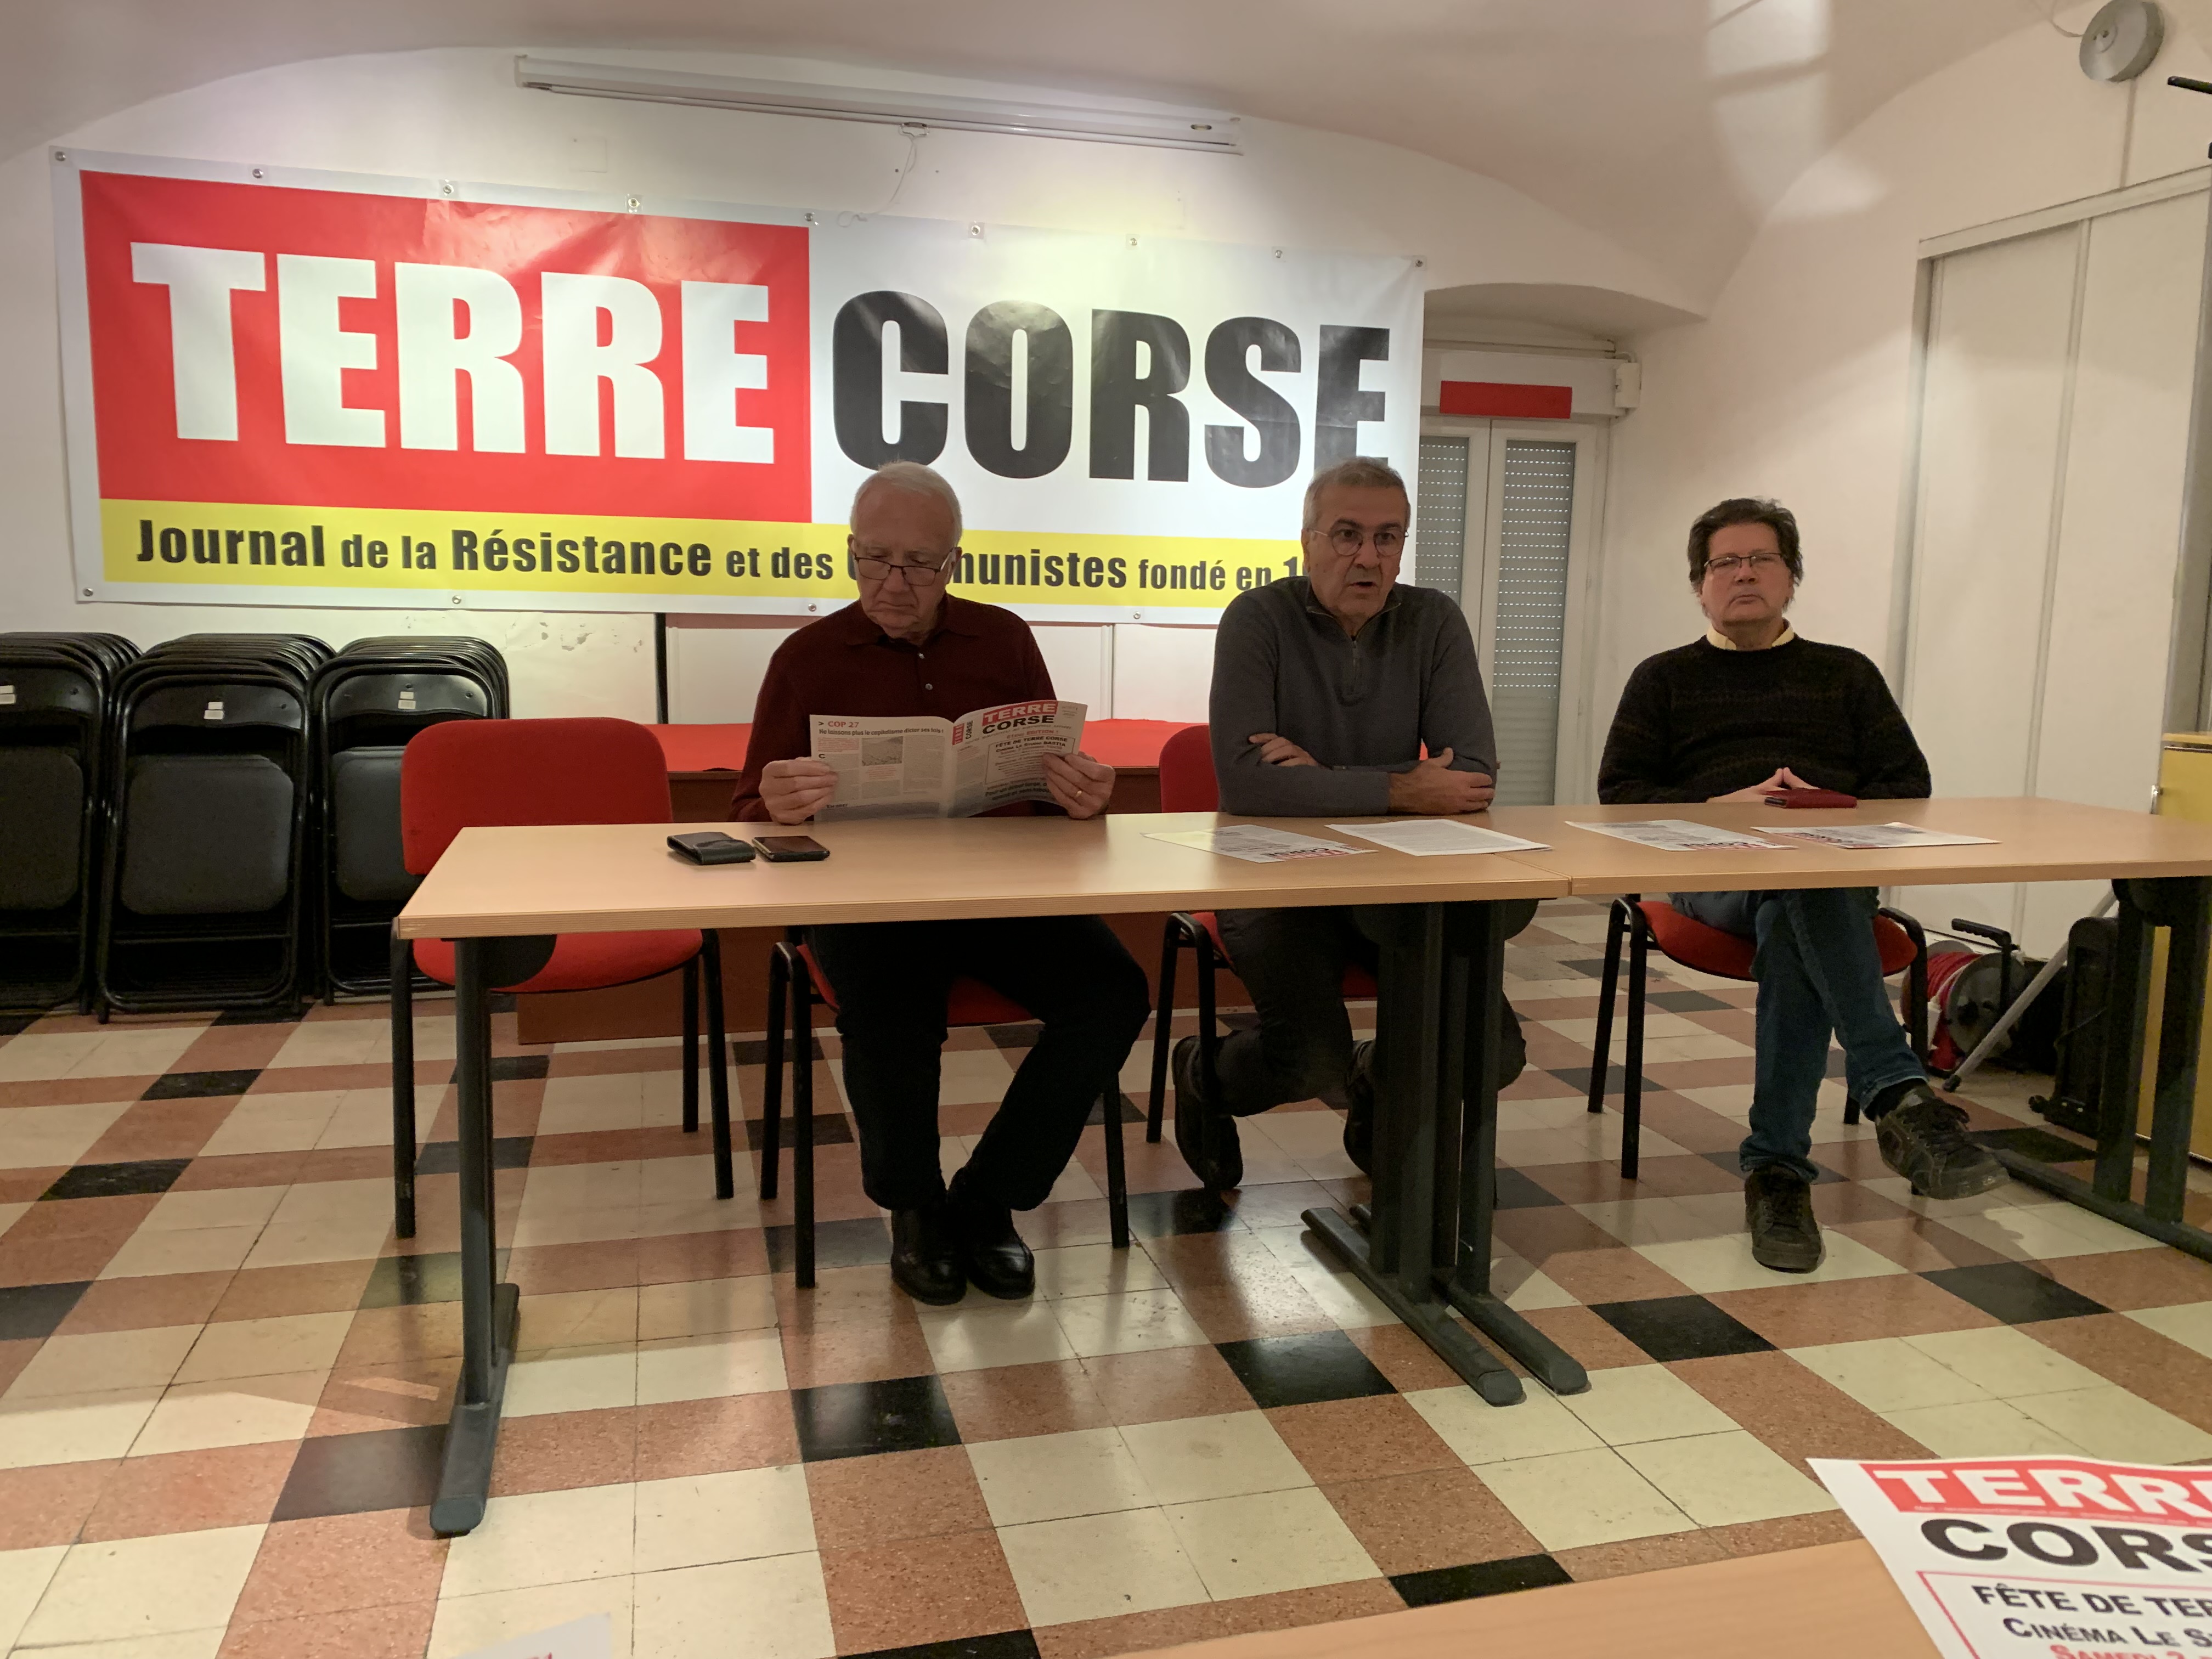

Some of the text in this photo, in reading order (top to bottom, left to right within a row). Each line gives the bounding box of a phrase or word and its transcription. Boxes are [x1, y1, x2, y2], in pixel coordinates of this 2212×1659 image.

[130, 241, 1390, 488] TERRE CORSE
[137, 519, 325, 567] Journal
[341, 534, 388, 568] de
[401, 535, 437, 570] la
[452, 528, 712, 577] Résistance
[726, 547, 760, 578] et
[771, 546, 833, 580] des
[1138, 558, 1226, 591] fondé
[1235, 566, 1271, 591] en
[982, 715, 1055, 735] CORSE
[983, 703, 1057, 723] TERRE
[1873, 1468, 2212, 1518] TERR
[1971, 1583, 2078, 1612] FÊTE
[2081, 1593, 2142, 1615] DE
